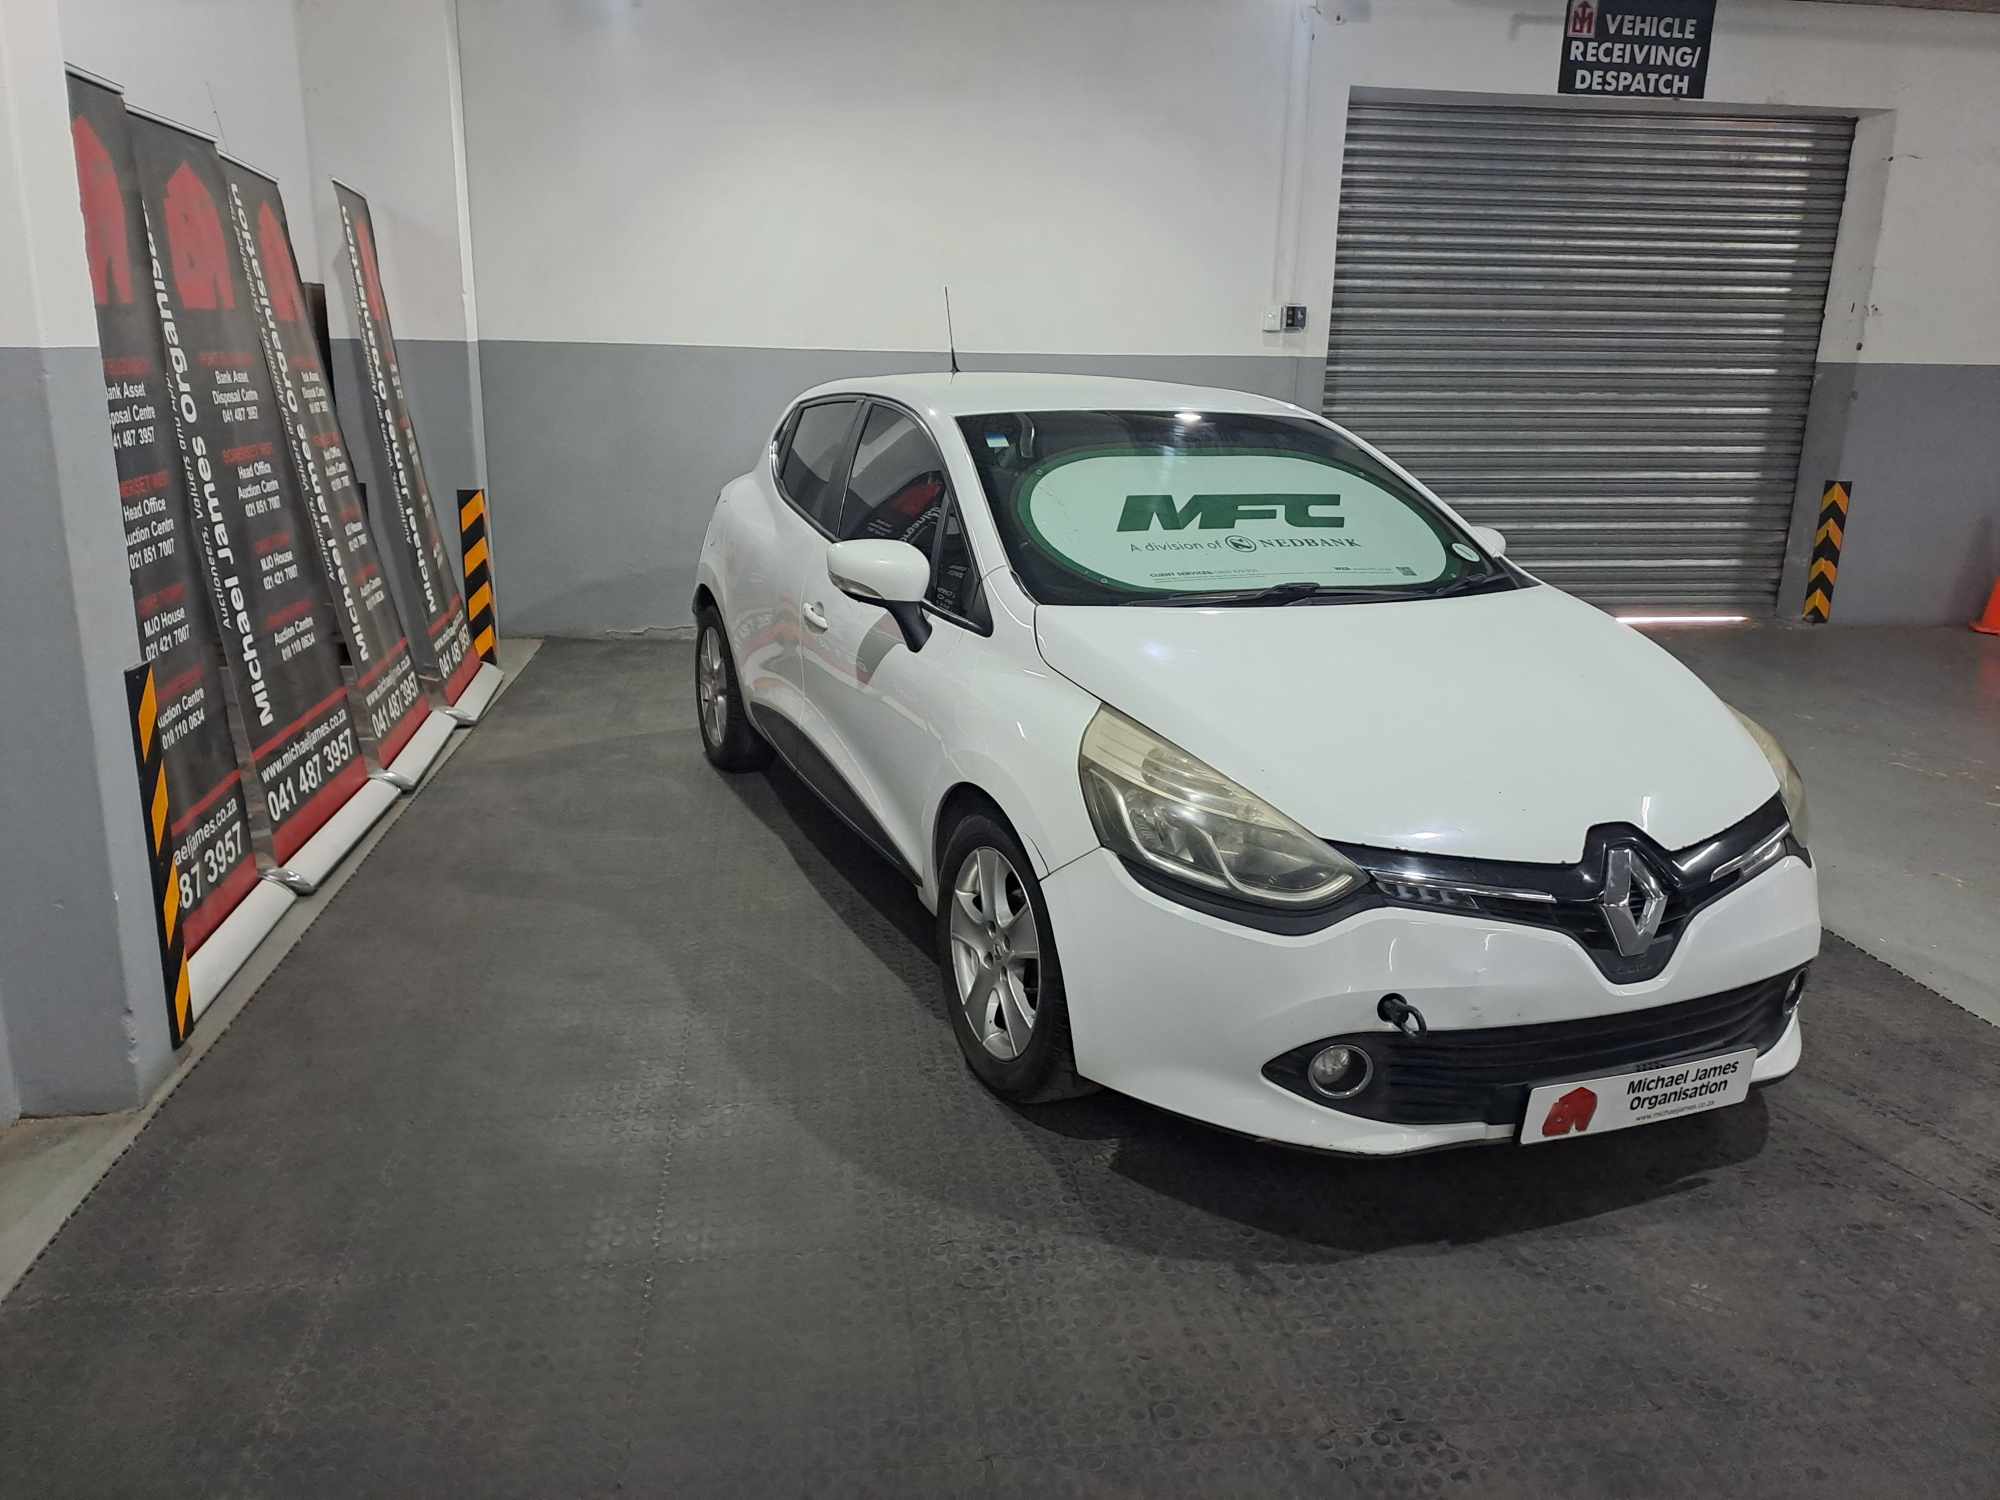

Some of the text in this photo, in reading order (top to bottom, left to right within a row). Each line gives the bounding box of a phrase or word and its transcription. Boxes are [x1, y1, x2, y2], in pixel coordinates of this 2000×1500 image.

[1605, 14, 1697, 40] VEHICLE
[1569, 41, 1701, 68] RECEIVING/
[1574, 69, 1690, 95] DESPATCH
[231, 183, 298, 413] Organisation
[342, 205, 387, 400] Organisation
[123, 381, 146, 398] Asset
[110, 404, 156, 430] posal Centre
[113, 426, 155, 450] 41 487 3957
[384, 408, 411, 500] James
[183, 456, 204, 519] Valuers
[297, 423, 332, 529] James
[123, 496, 166, 522] Head Office
[191, 436, 234, 565] James
[1116, 493, 1345, 532] MFC
[151, 518, 174, 536] Centre
[1129, 536, 1362, 552] A division of NEDBANK
[129, 538, 175, 570] 021 851 7007
[405, 507, 437, 613] Michael
[202, 526, 232, 630] Auctioneers,
[327, 538, 369, 661] Michael
[143, 607, 185, 638] MJO House
[145, 624, 190, 661] 021 421 7007
[224, 576, 274, 727] Michael
[157, 687, 205, 729] uction Centre
[371, 671, 420, 738] 041 487 3957
[162, 707, 205, 750] 010 110 0634
[261, 709, 347, 784] www.michaeljames.co.za
[268, 728, 352, 821] 041 487 3957
[179, 821, 242, 909] 87 3957
[1626, 1061, 1739, 1095] Michael James
[1629, 1079, 1728, 1111] Organisation
